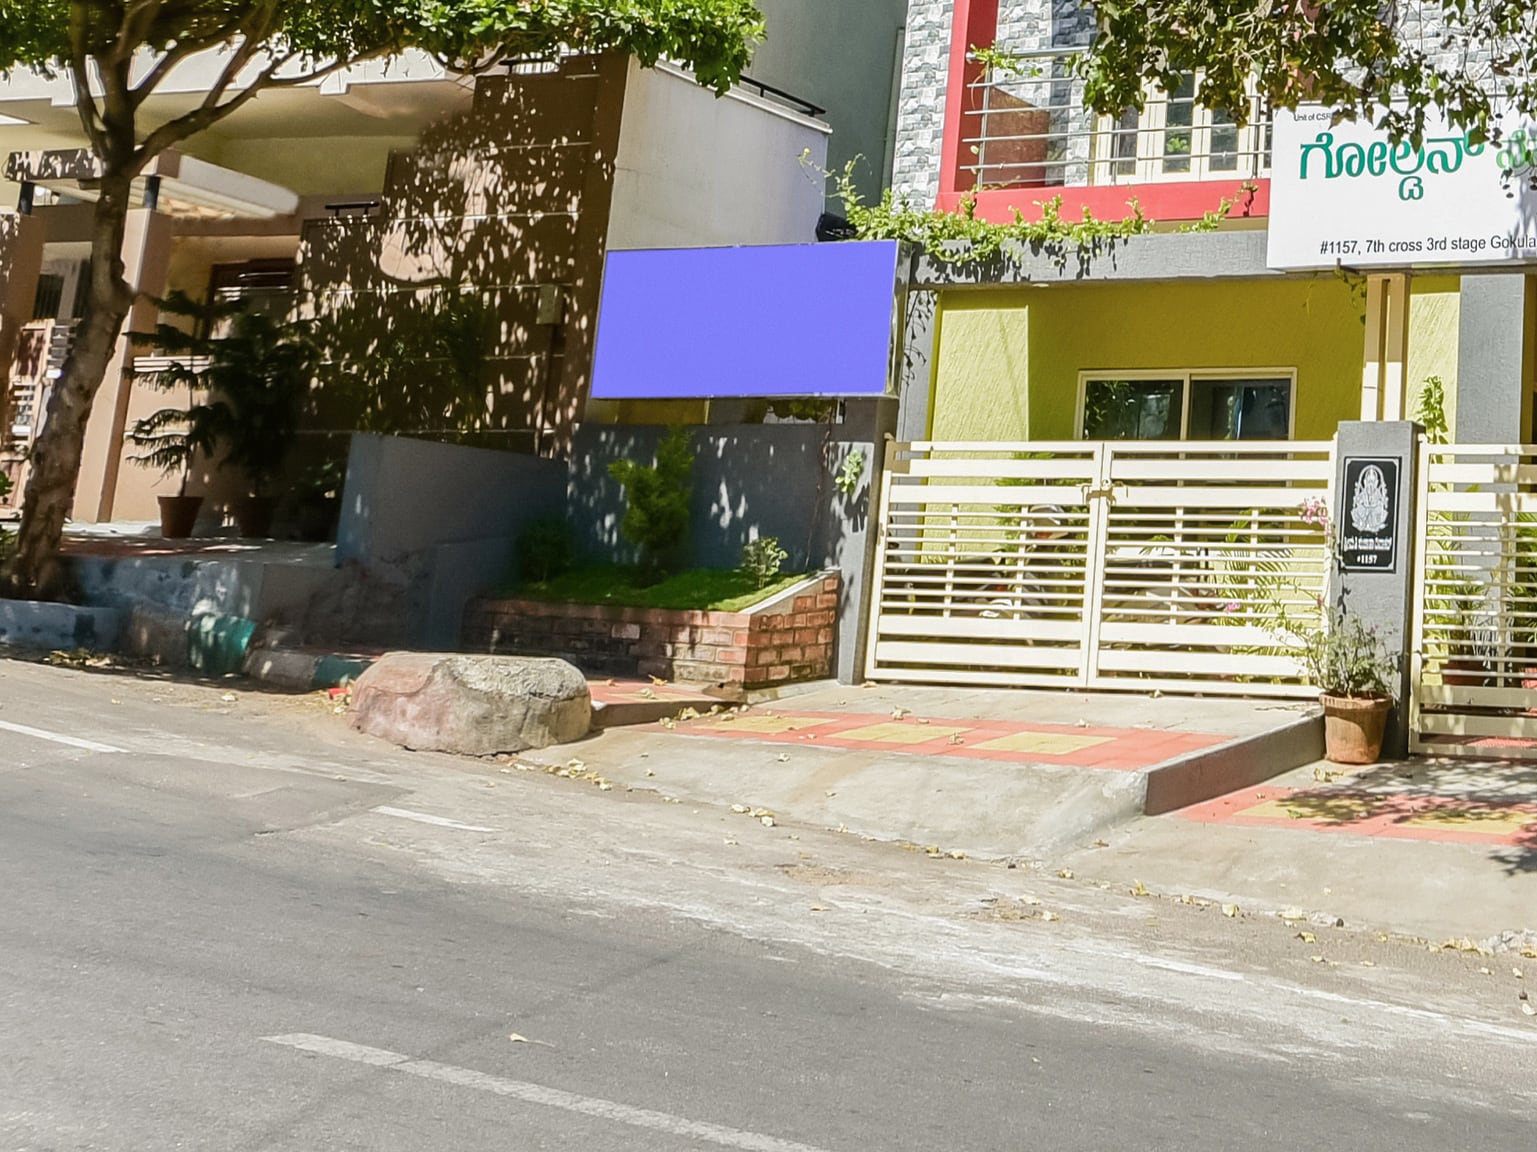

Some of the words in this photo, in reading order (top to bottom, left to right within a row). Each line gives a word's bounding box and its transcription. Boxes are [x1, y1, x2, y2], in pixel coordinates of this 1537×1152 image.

[1308, 112, 1315, 121] of
[1319, 239, 1361, 256] #1157,
[1366, 238, 1385, 254] 7th
[1388, 239, 1423, 253] cross
[1426, 237, 1447, 251] 3rd
[1451, 235, 1486, 253] stage
